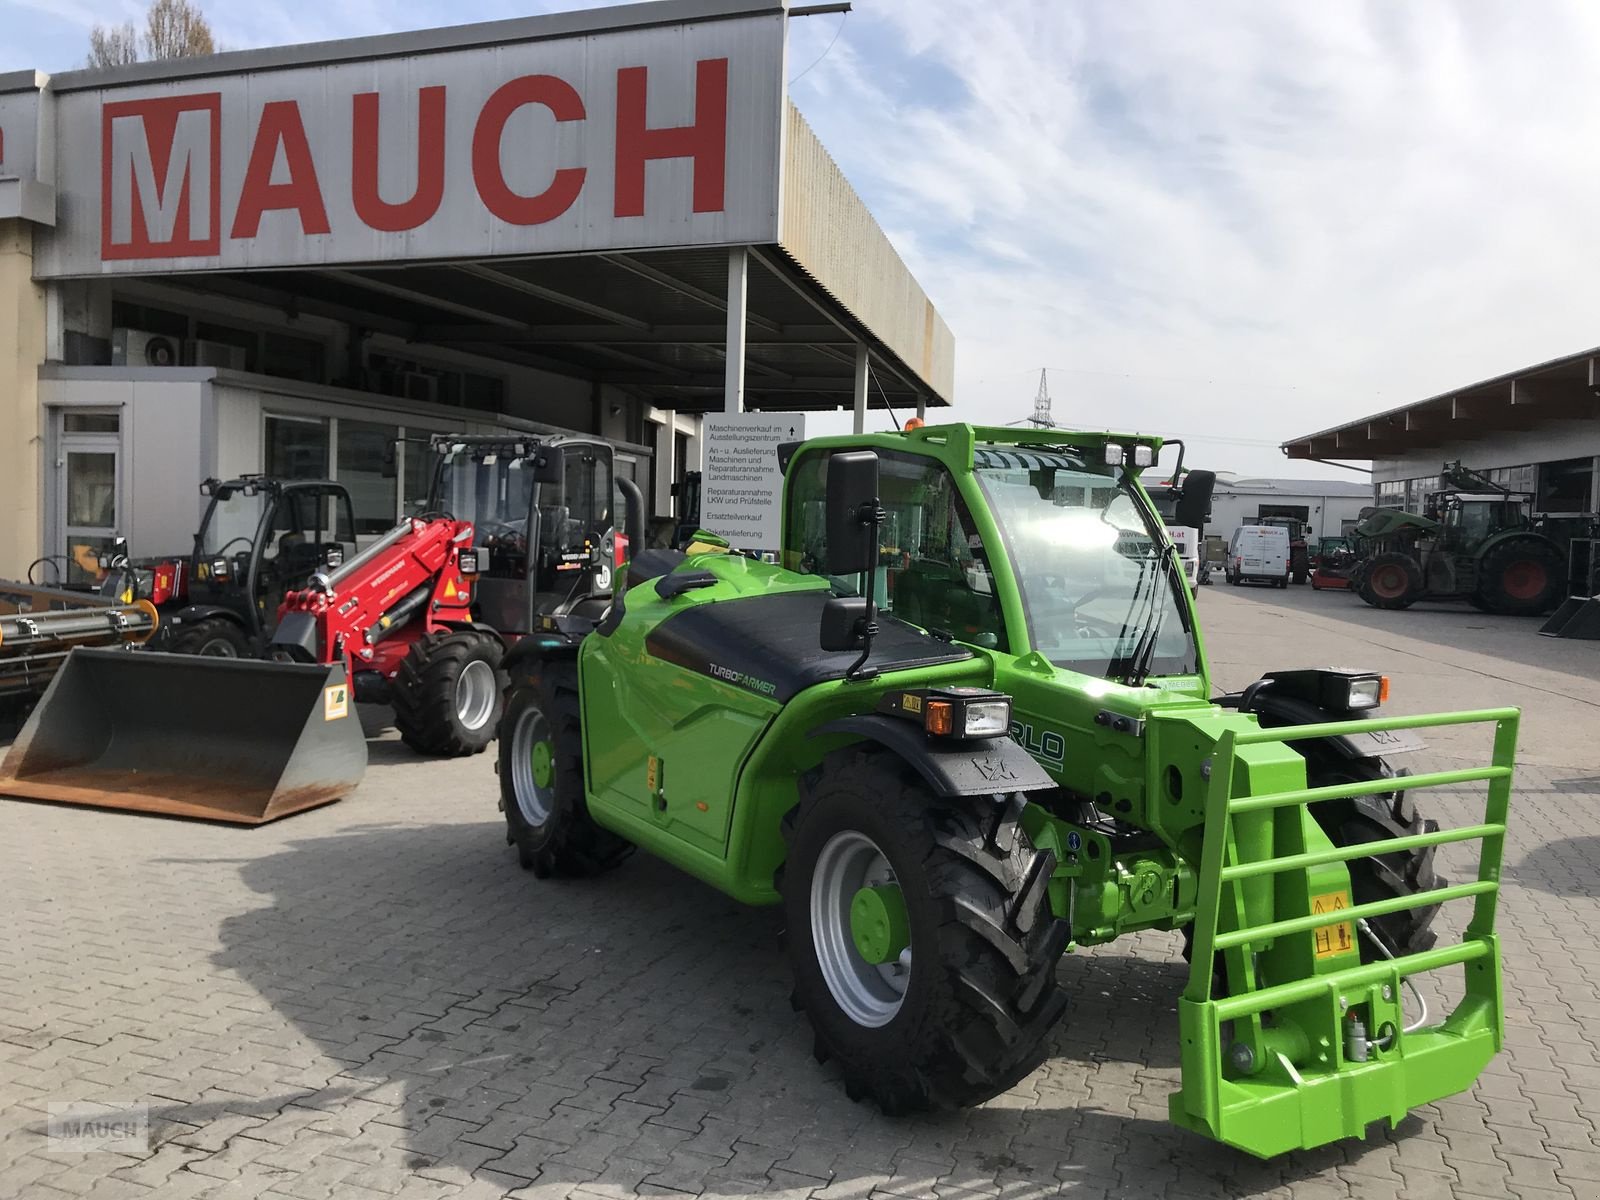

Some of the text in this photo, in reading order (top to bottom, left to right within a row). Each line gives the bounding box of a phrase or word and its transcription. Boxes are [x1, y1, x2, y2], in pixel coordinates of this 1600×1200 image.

[102, 57, 728, 260] MAUCH
[709, 424, 782, 432] Maschinenverkauf im
[709, 433, 781, 442] Ausstellungszentrum
[733, 448, 776, 456] Auslieferung
[708, 465, 774, 474] Reparaturannahme
[708, 473, 763, 481] Landmaschinen
[707, 487, 773, 497] Reparaturannahme
[740, 497, 772, 505] Prüfstelle
[706, 512, 762, 521] Ersatzteilverkauf
[709, 662, 777, 695] TURBOFARMER
[1010, 719, 1065, 761] RLO
